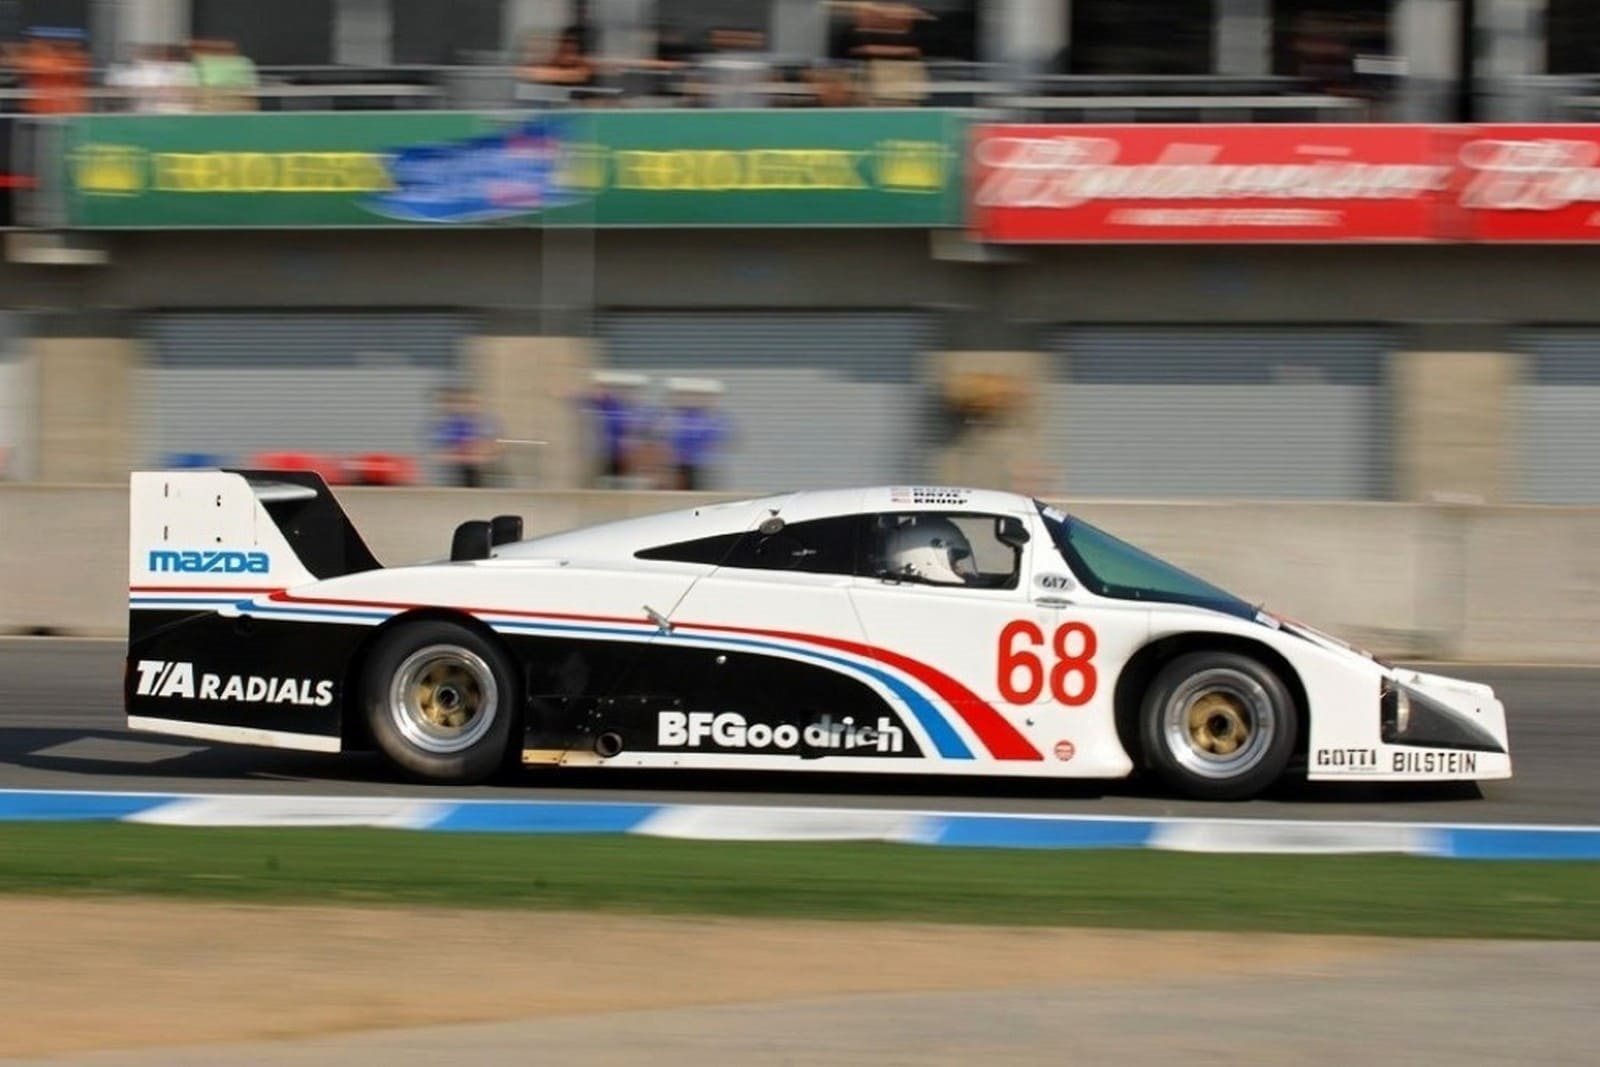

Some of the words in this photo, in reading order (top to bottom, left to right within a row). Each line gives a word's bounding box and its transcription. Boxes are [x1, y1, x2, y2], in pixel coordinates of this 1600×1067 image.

[997, 619, 1098, 707] 68
[199, 672, 334, 707] RADIALS
[1317, 749, 1377, 766] GOTTI
[1392, 751, 1477, 774] BILSTEIN
